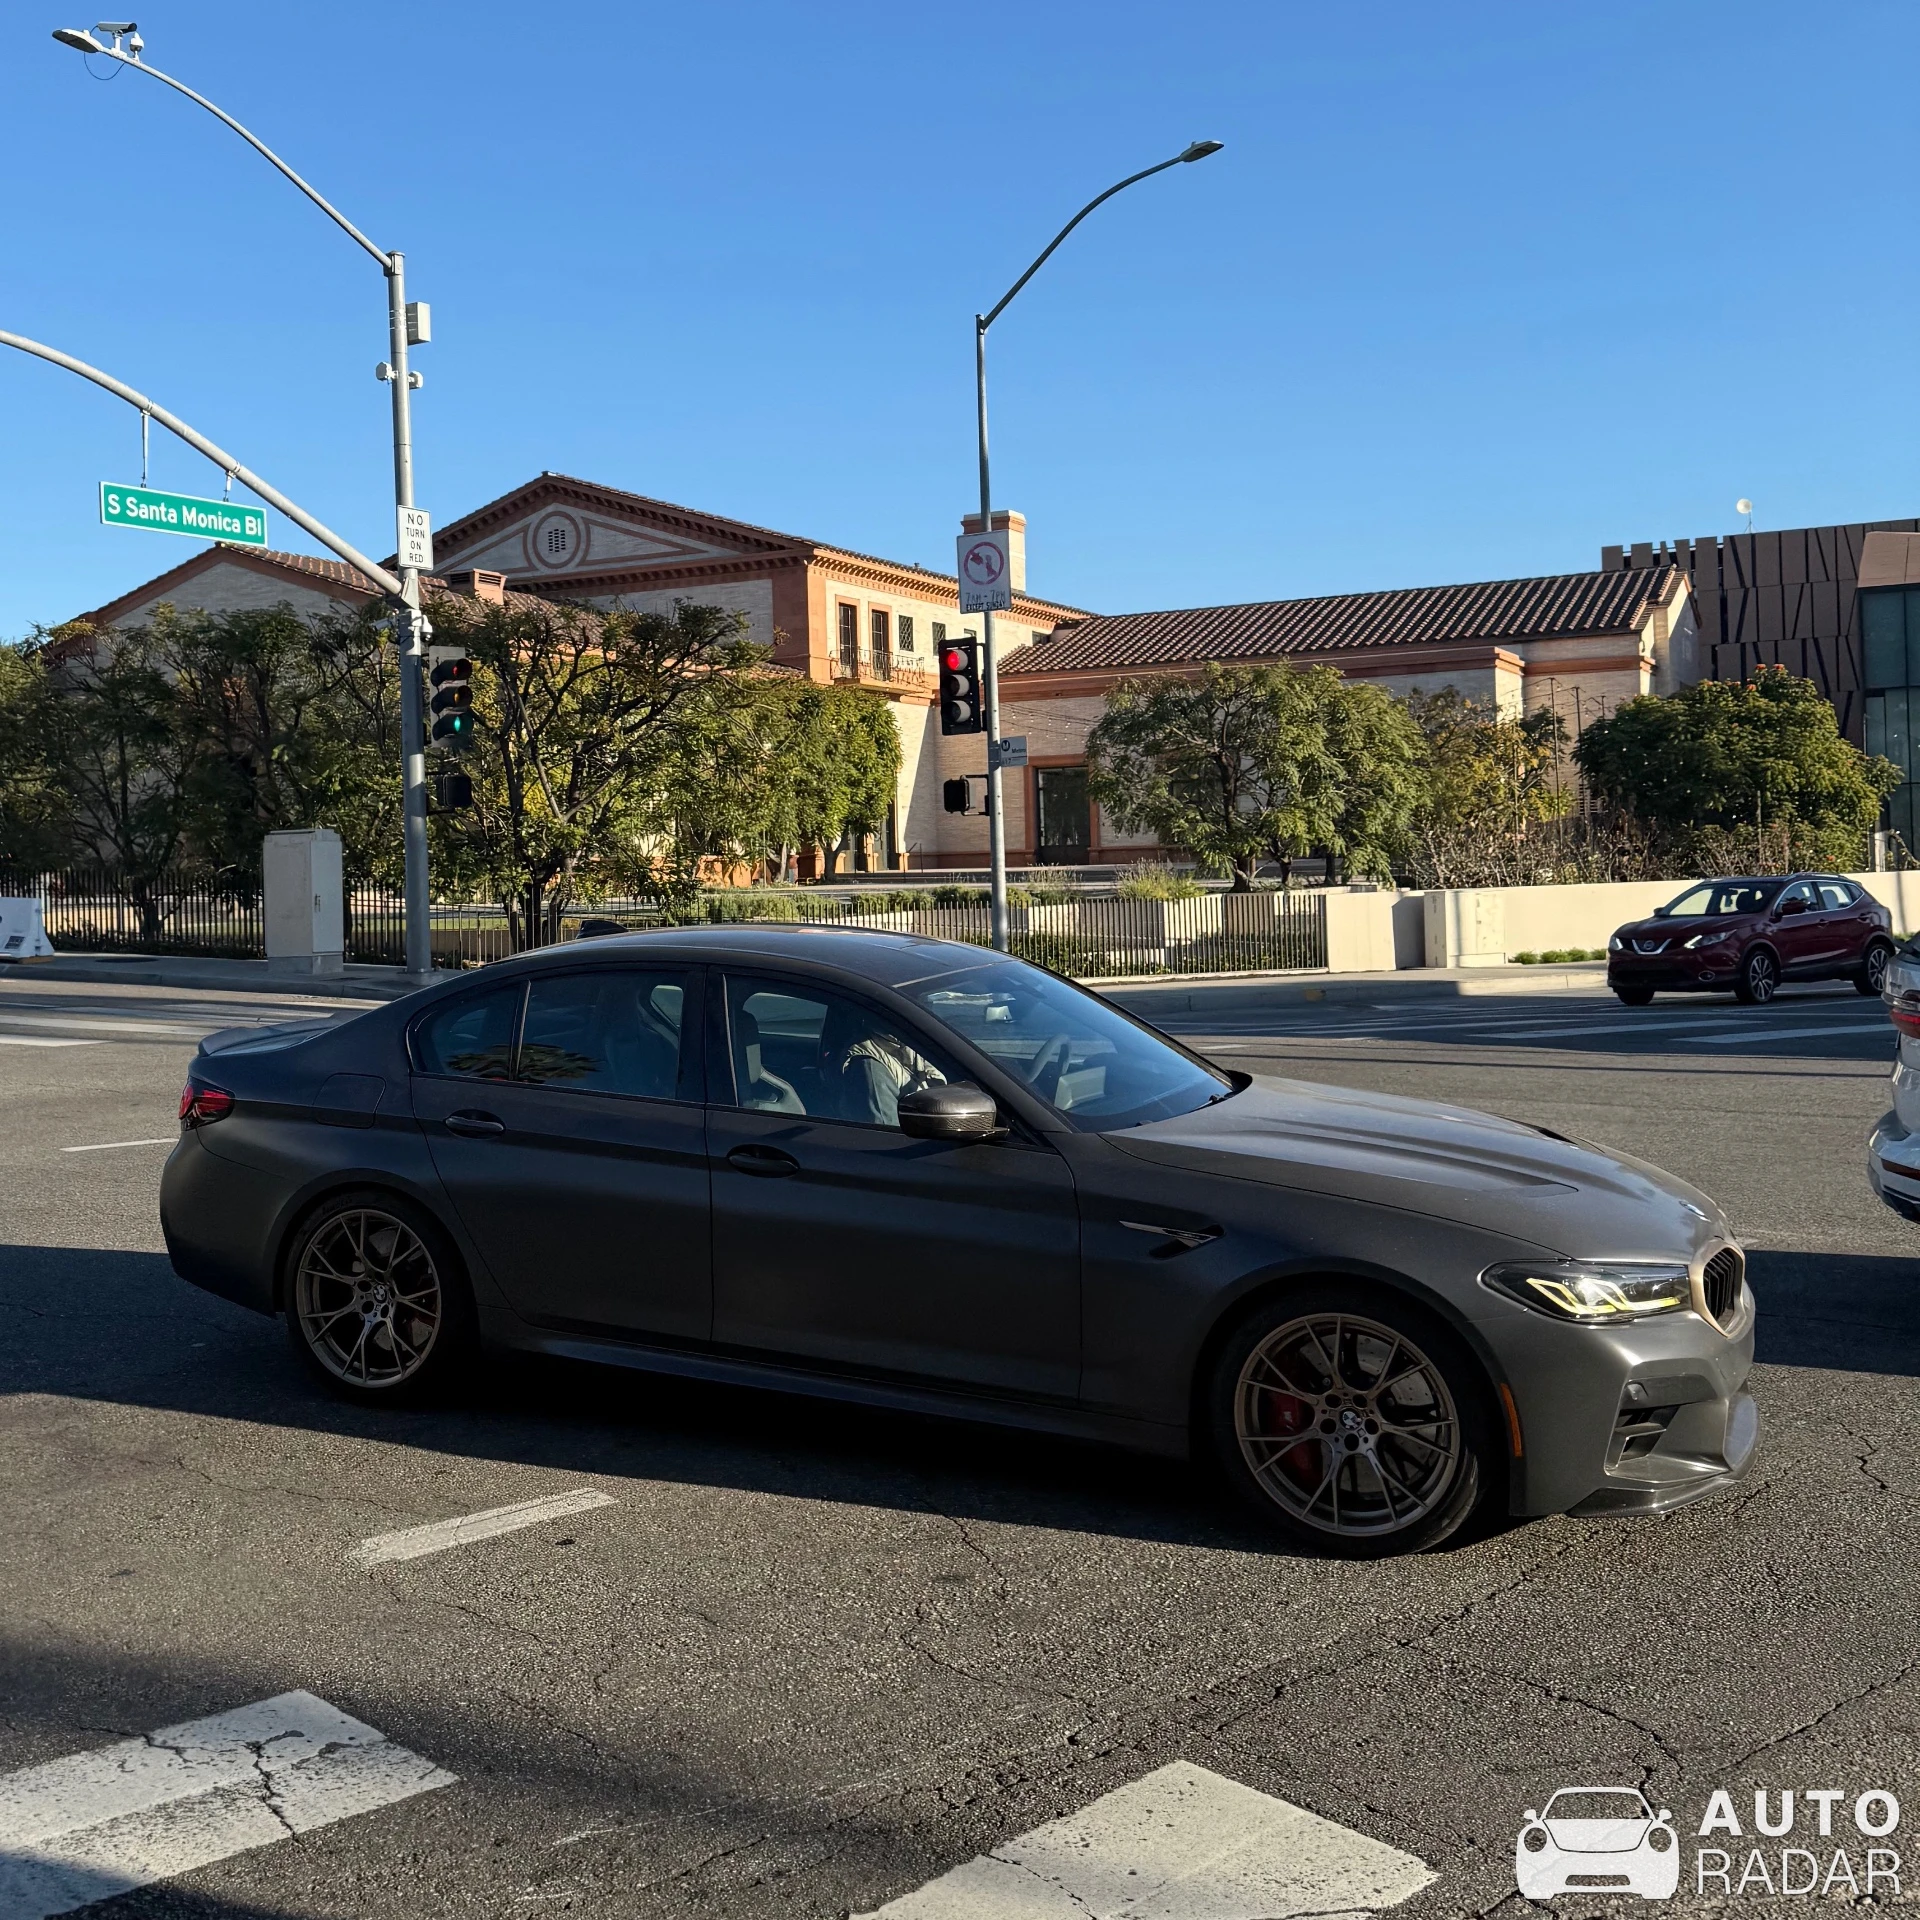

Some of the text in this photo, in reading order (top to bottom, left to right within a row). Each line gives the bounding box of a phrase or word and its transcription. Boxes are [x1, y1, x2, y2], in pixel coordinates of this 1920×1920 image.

[107, 493, 262, 537] S Santa Monica Bl
[407, 512, 424, 526] NO
[406, 527, 425, 539] TURN
[410, 540, 422, 551] ON
[409, 552, 424, 563] RED
